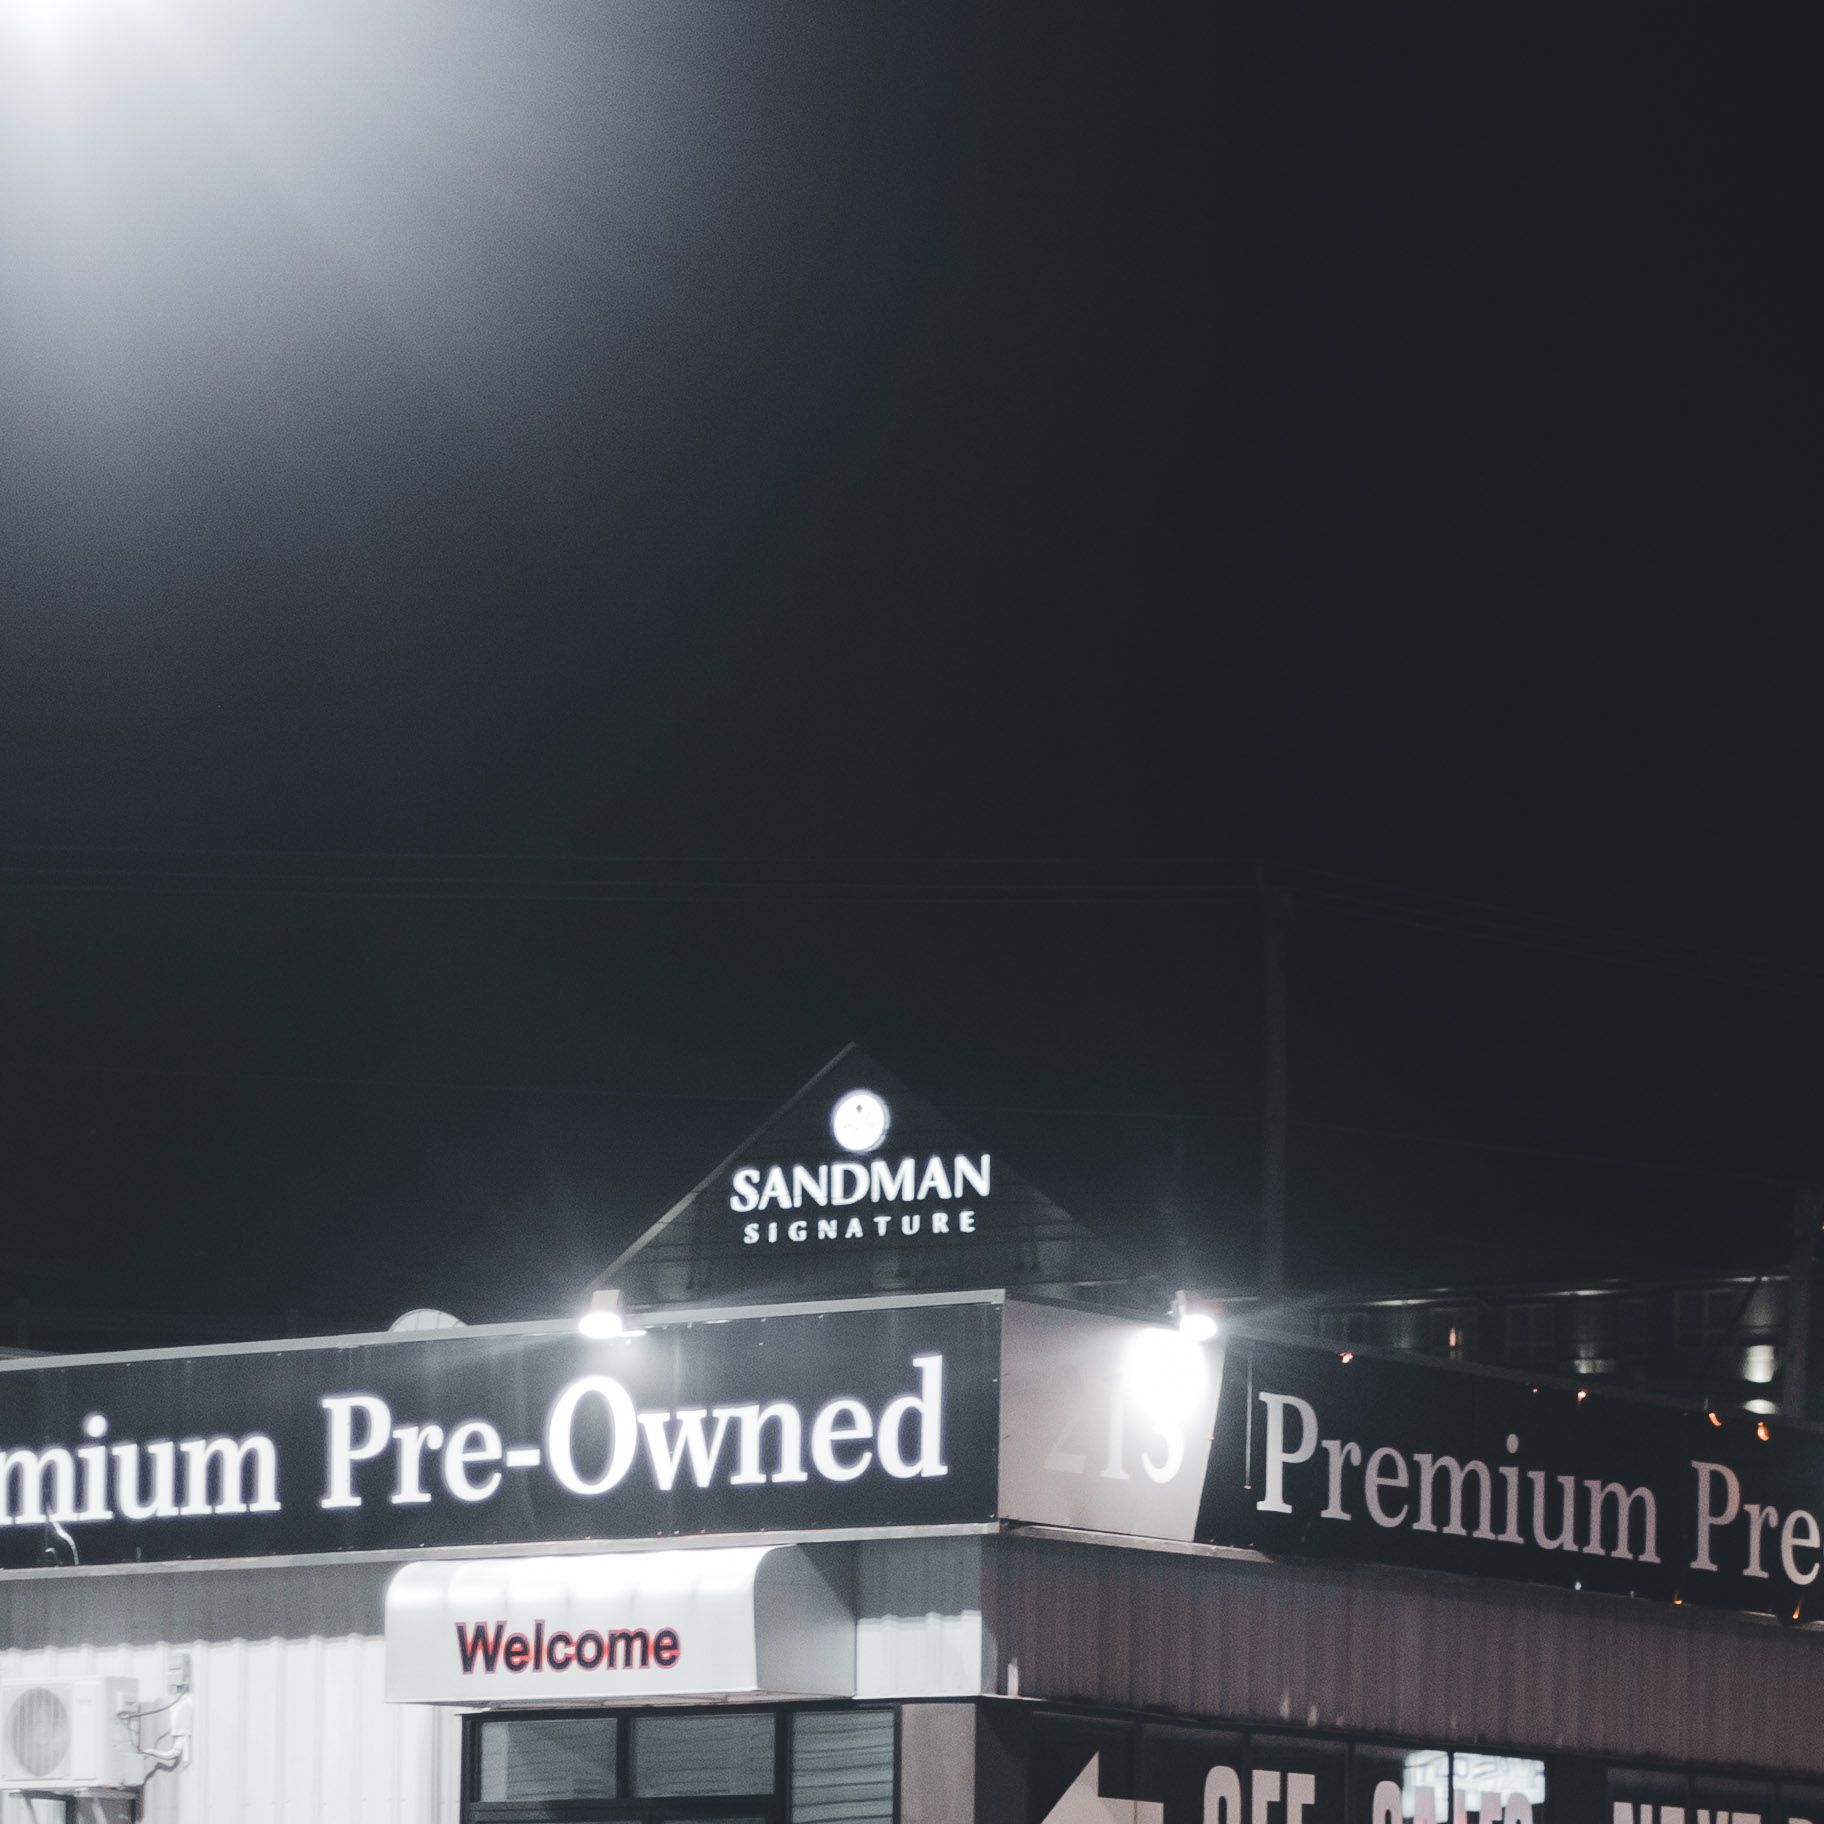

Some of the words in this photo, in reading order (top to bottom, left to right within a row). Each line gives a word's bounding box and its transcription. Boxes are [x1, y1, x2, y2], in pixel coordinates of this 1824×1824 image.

[730, 1154, 991, 1212] SANDMAN
[743, 1211, 975, 1244] SIGNATURE
[321, 1354, 948, 1509] Pre-Owned
[1257, 1391, 1661, 1564] Premium
[455, 1619, 681, 1675] Welcome
